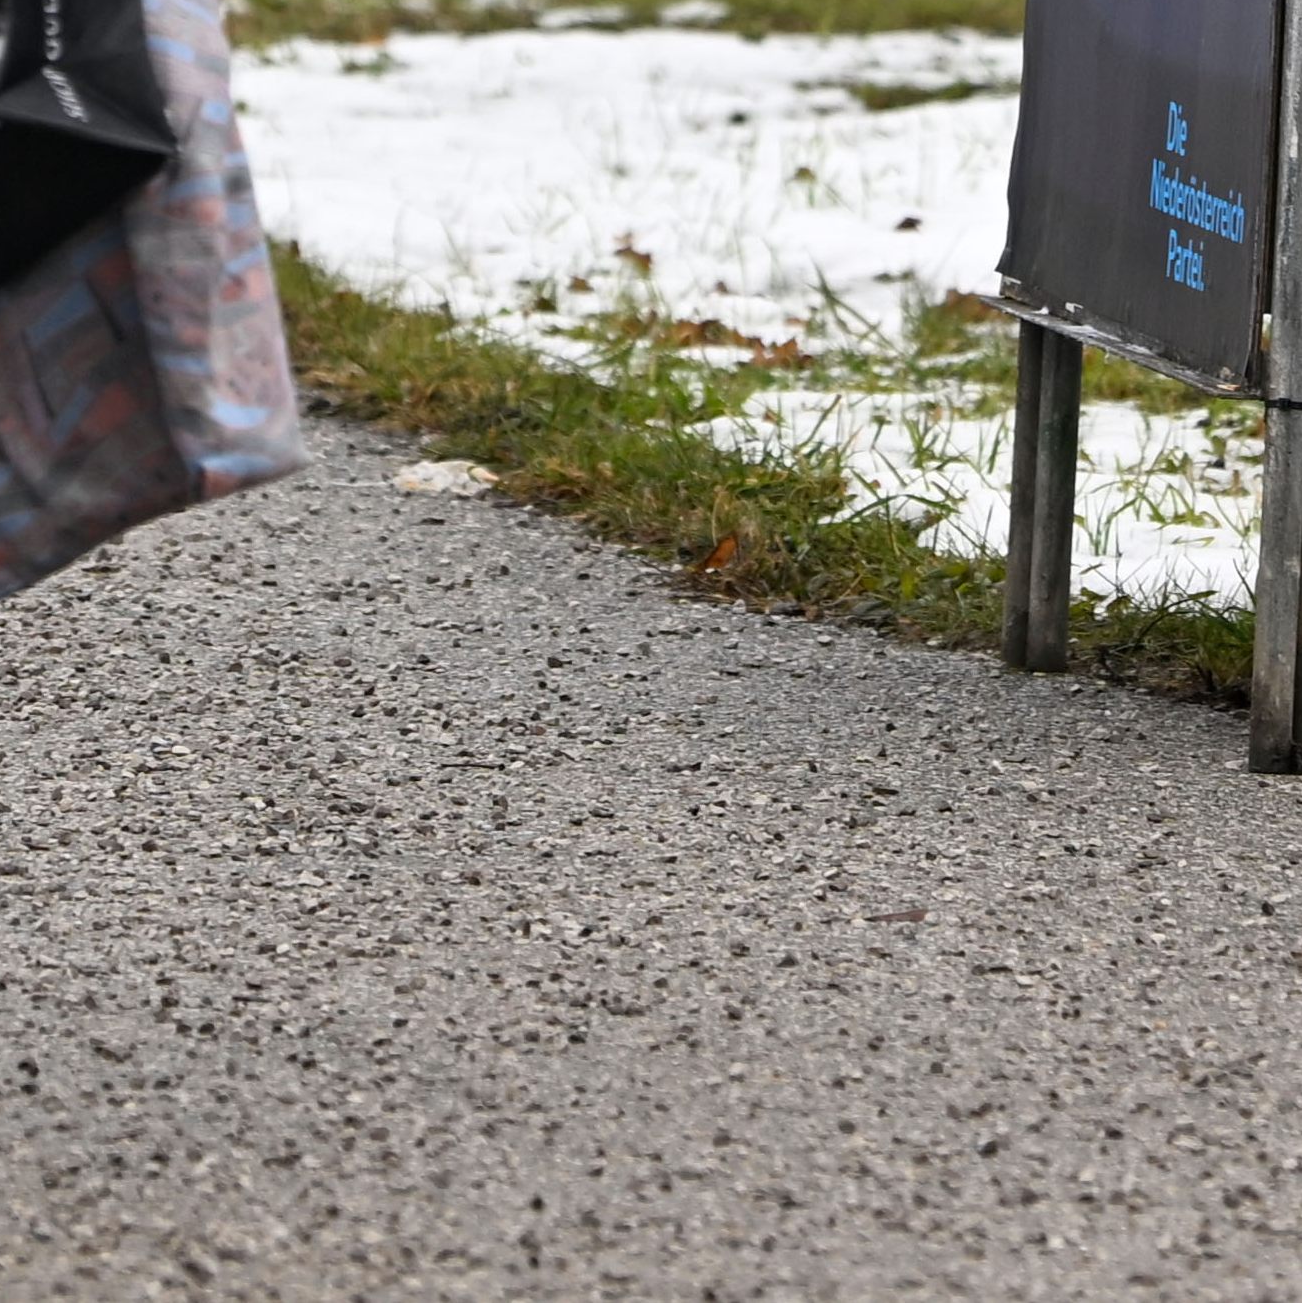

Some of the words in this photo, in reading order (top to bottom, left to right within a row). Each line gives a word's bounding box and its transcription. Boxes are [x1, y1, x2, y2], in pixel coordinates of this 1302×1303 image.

[1166, 101, 1187, 157] Die
[1150, 158, 1245, 244] Niederösterreich
[1166, 229, 1204, 291] Partei.
